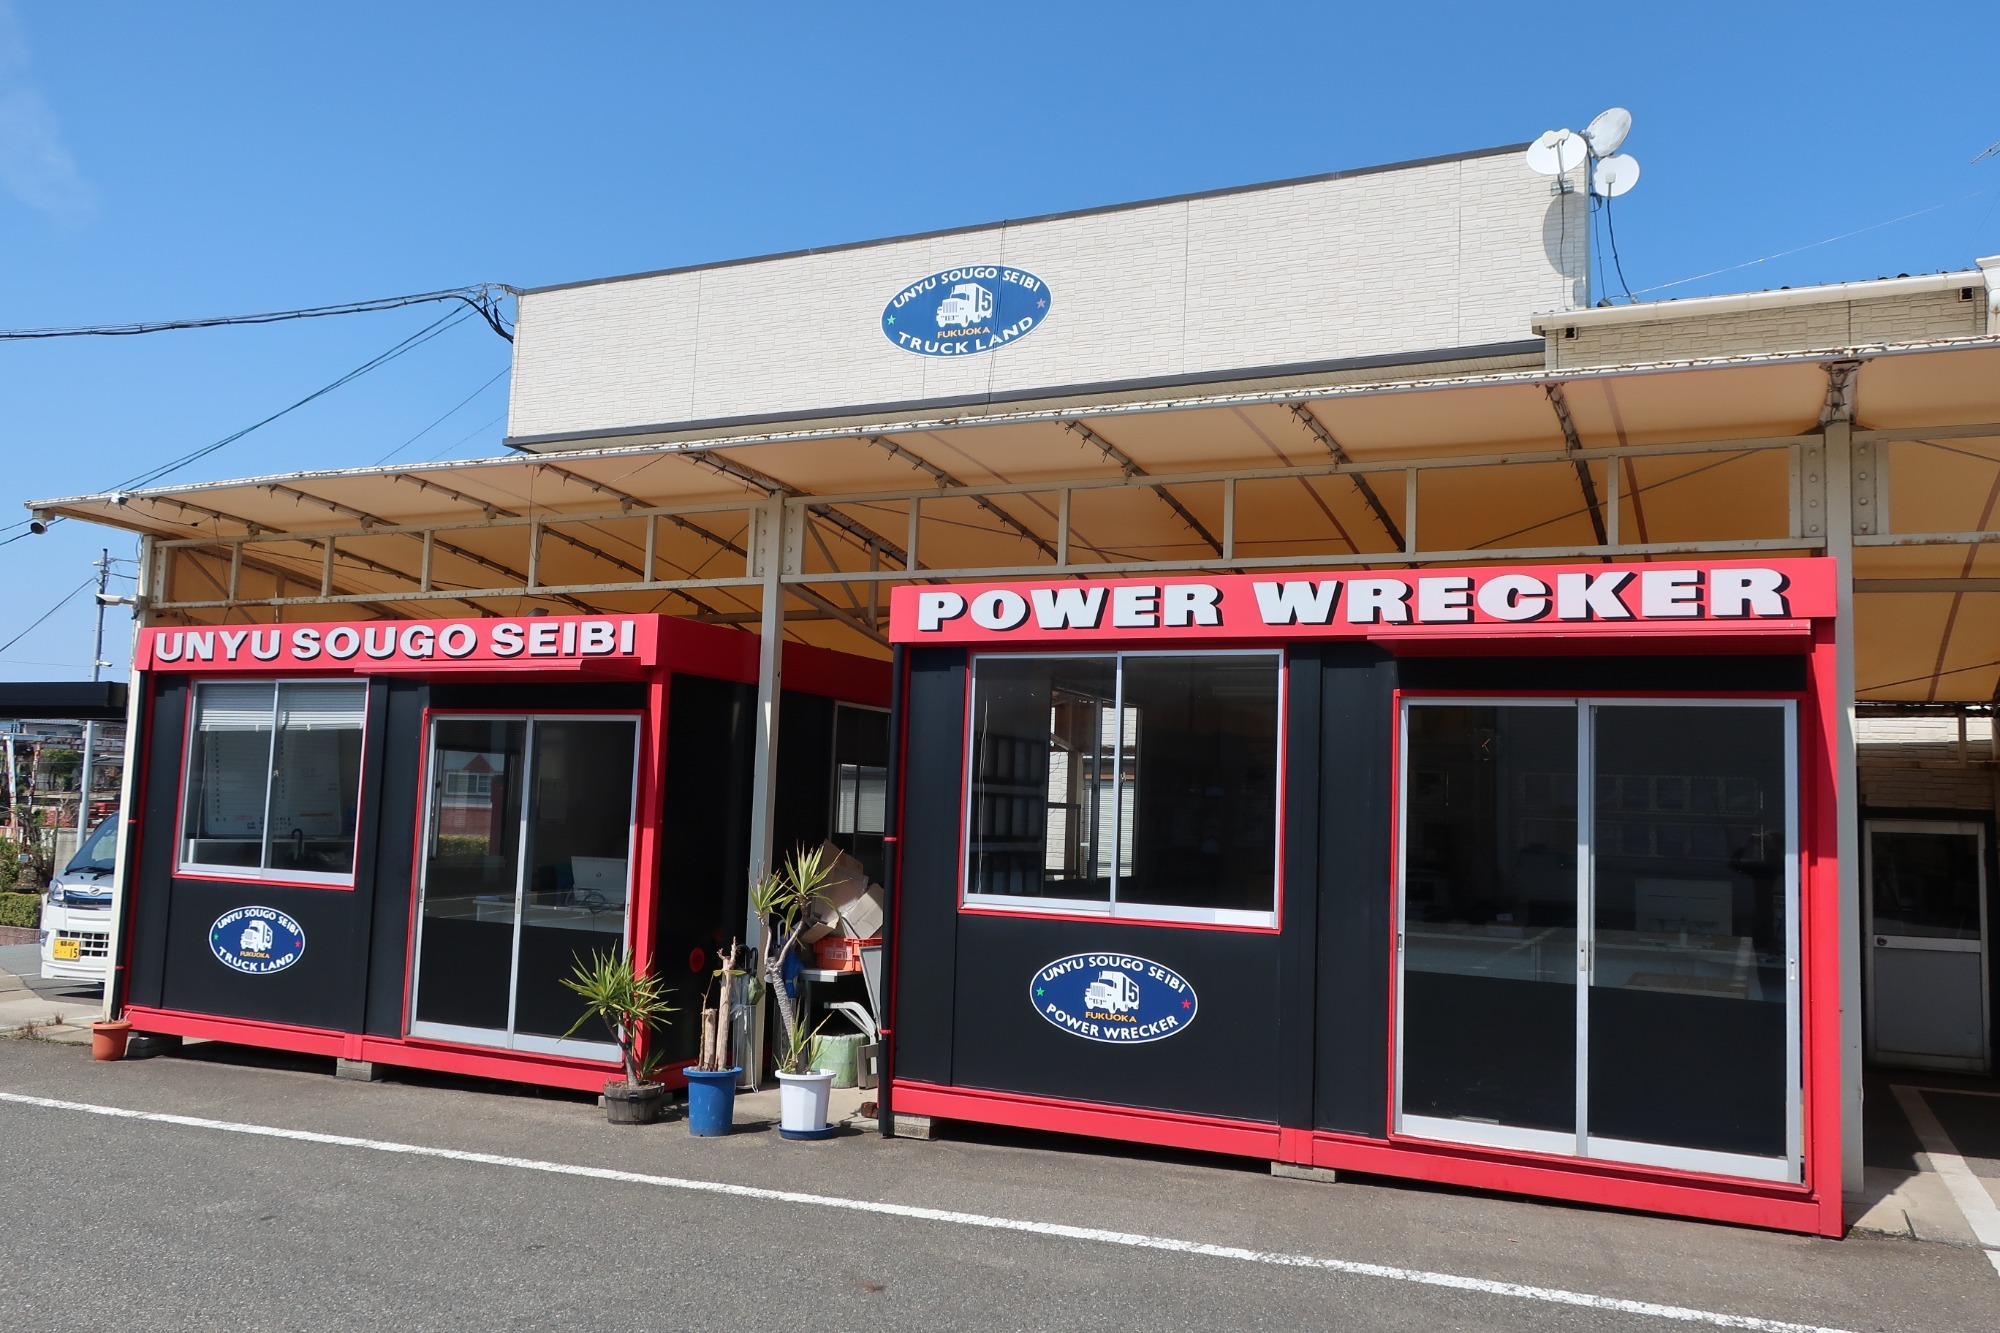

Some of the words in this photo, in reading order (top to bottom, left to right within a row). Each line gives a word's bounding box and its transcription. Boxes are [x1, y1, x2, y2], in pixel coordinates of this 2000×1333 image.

[893, 277, 936, 308] UNYU
[941, 267, 997, 284] SOUGO
[1002, 270, 1041, 292] SEIBI
[898, 331, 968, 354] TRUCK
[975, 316, 1033, 351] LAND
[937, 326, 990, 339] FUKUOKA
[916, 583, 1225, 632] POWER
[1251, 566, 1791, 627] WRECKER
[155, 628, 282, 662] UNYU
[291, 622, 477, 660] SOUGO
[489, 620, 637, 657] SEIBI
[217, 911, 243, 929] UNYU
[244, 908, 276, 920] SOUGO
[277, 916, 299, 936] SEIBI
[218, 946, 258, 971] TRUCK
[260, 953, 294, 971] LAND
[239, 950, 270, 959] FUKUOKA
[1042, 957, 1084, 982] UNYU
[1088, 955, 1144, 972] SOUGO
[1148, 966, 1186, 994] SEIBI
[1045, 1003, 1100, 1037] POWER
[1103, 1015, 1179, 1040] WRECKER
[1085, 1011, 1137, 1023] FUKUOKA
